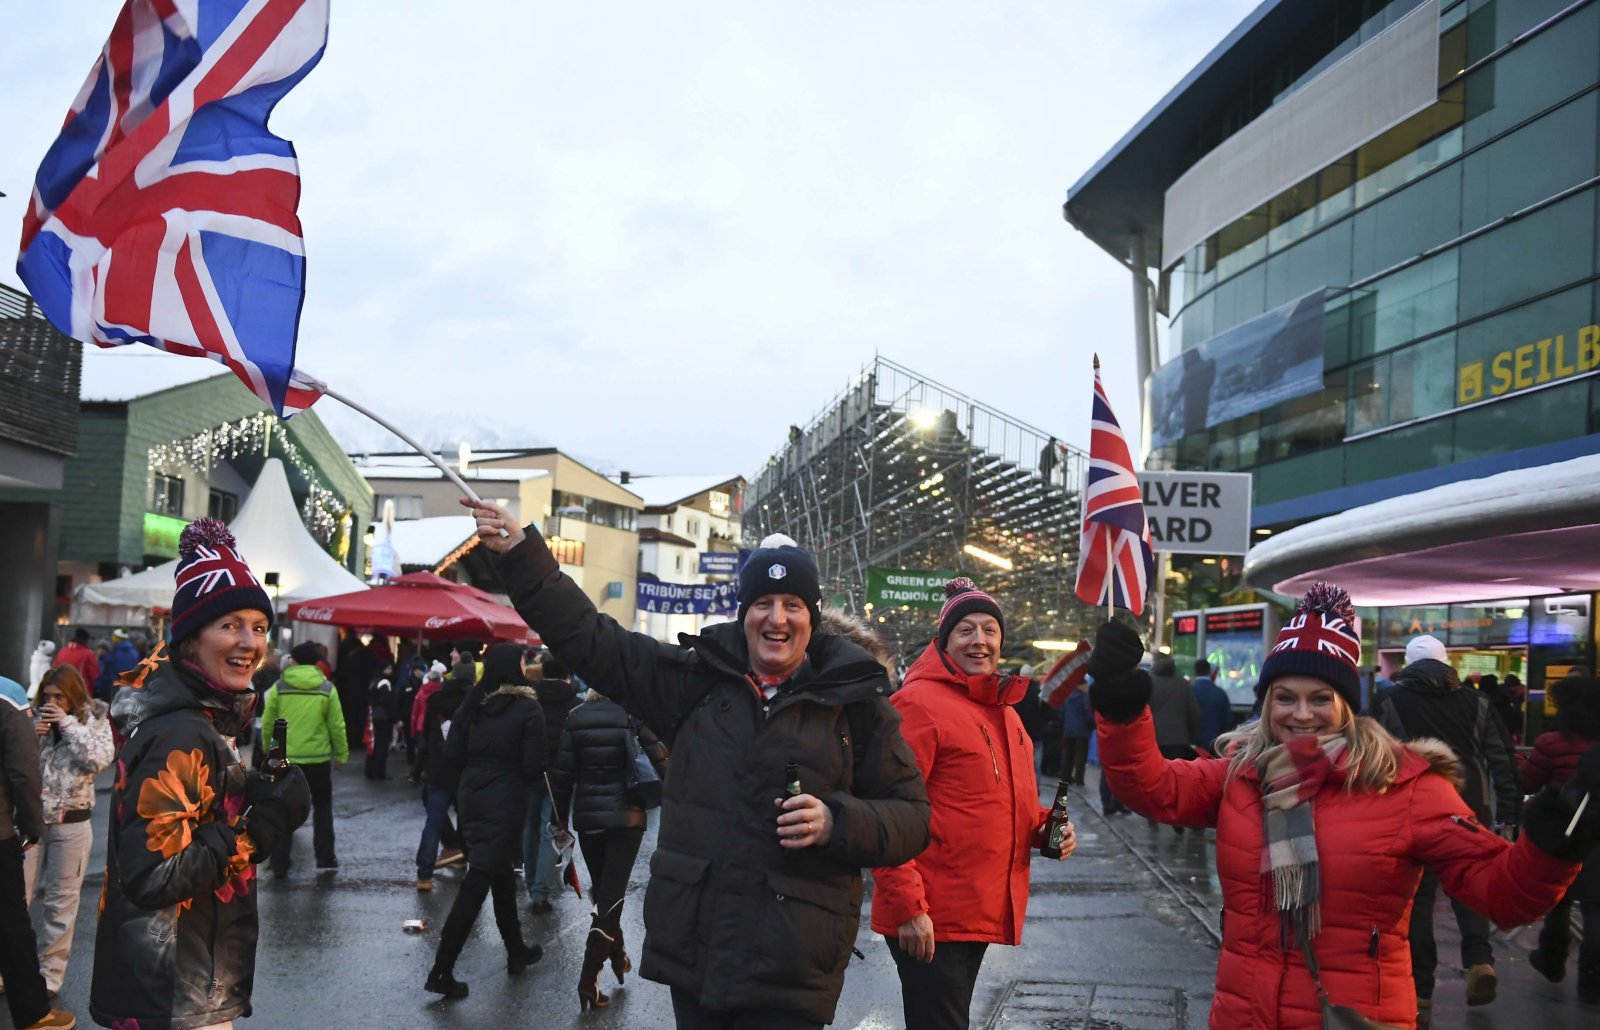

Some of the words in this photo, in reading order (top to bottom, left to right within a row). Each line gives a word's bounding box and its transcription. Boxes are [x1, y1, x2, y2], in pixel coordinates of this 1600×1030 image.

[1491, 324, 1600, 395] SEILB
[1142, 481, 1221, 508] LVER
[1148, 516, 1212, 543] ARD
[887, 575, 924, 586] GREEN
[927, 577, 951, 587] CAR
[638, 582, 692, 599] TRIBÜNE
[694, 582, 736, 600] SEOR
[881, 589, 928, 600] STADION
[932, 592, 946, 602] CA
[647, 599, 656, 612] A
[661, 602, 671, 613] B
[674, 602, 684, 614] C
